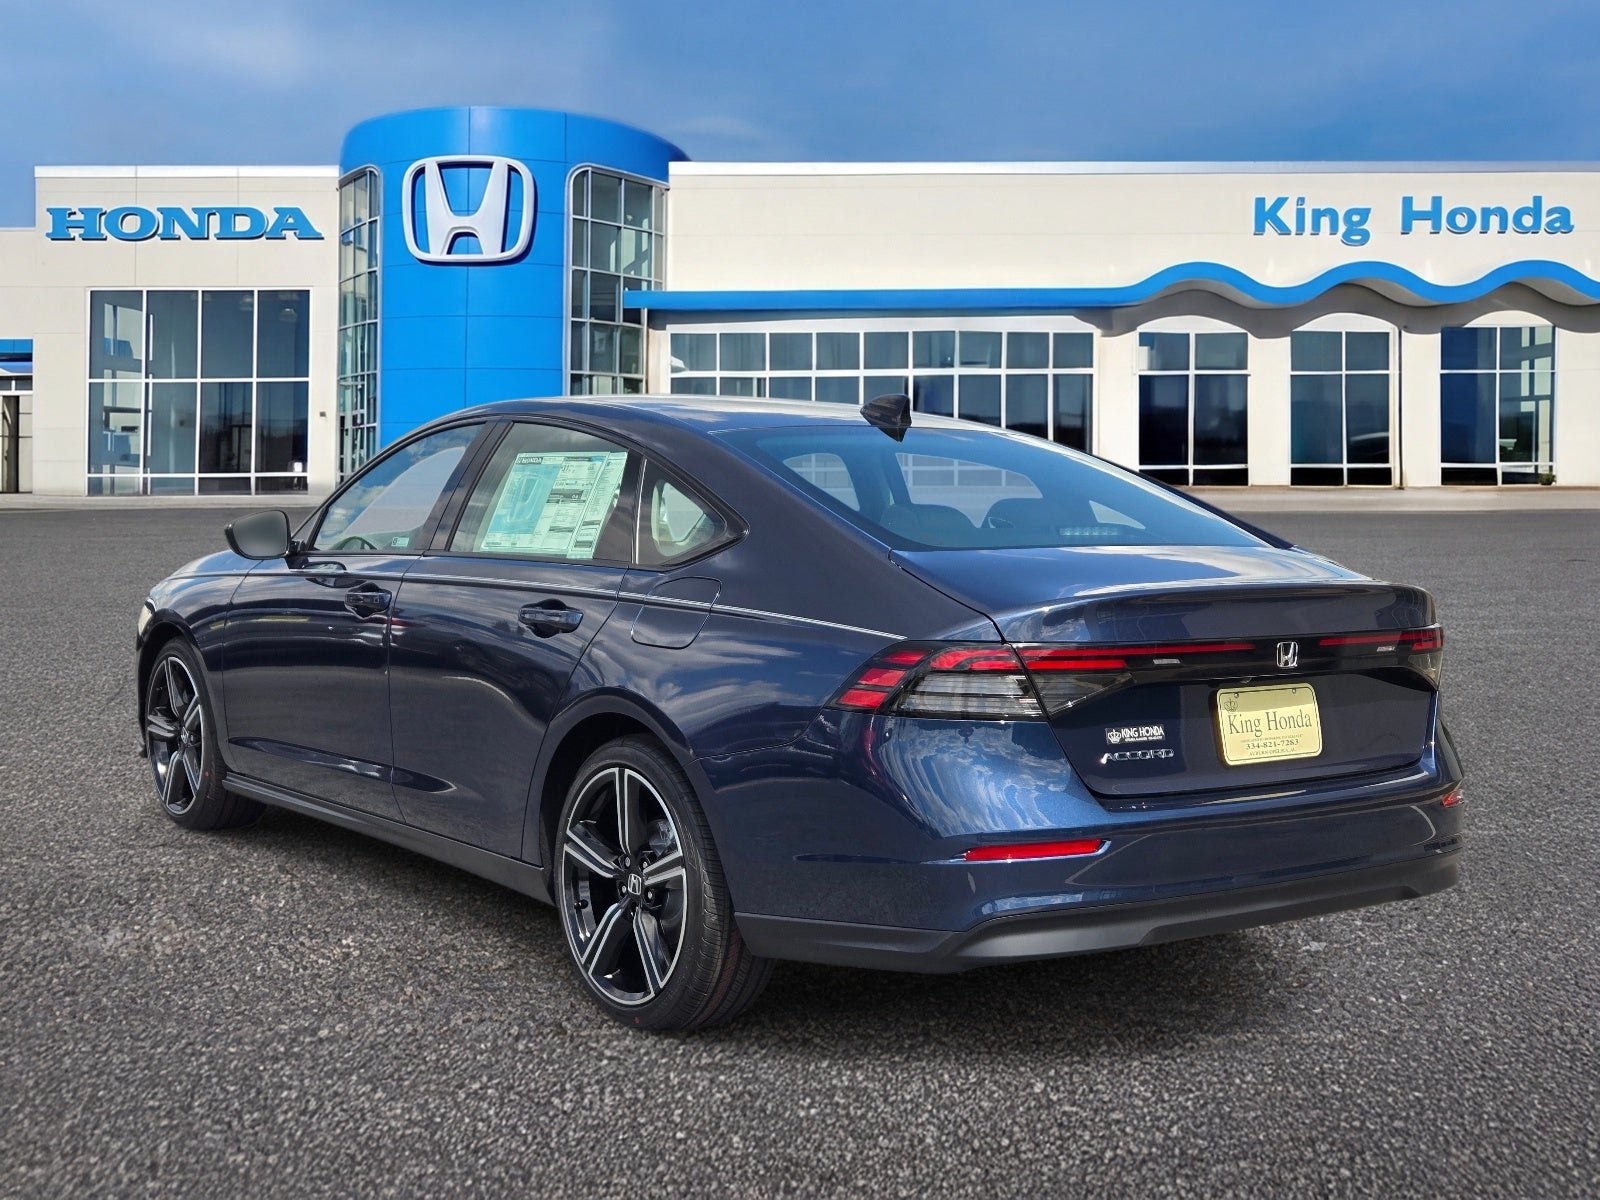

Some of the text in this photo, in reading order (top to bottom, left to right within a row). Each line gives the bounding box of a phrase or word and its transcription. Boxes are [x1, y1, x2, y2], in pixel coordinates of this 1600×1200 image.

[46, 206, 324, 241] HONDA
[1253, 195, 1574, 246] King Honda
[1121, 726, 1164, 738] KING HONDA
[1228, 709, 1312, 737] King Honda
[1246, 739, 1299, 750] 334-821-7283
[1100, 749, 1174, 765] ACCORD
